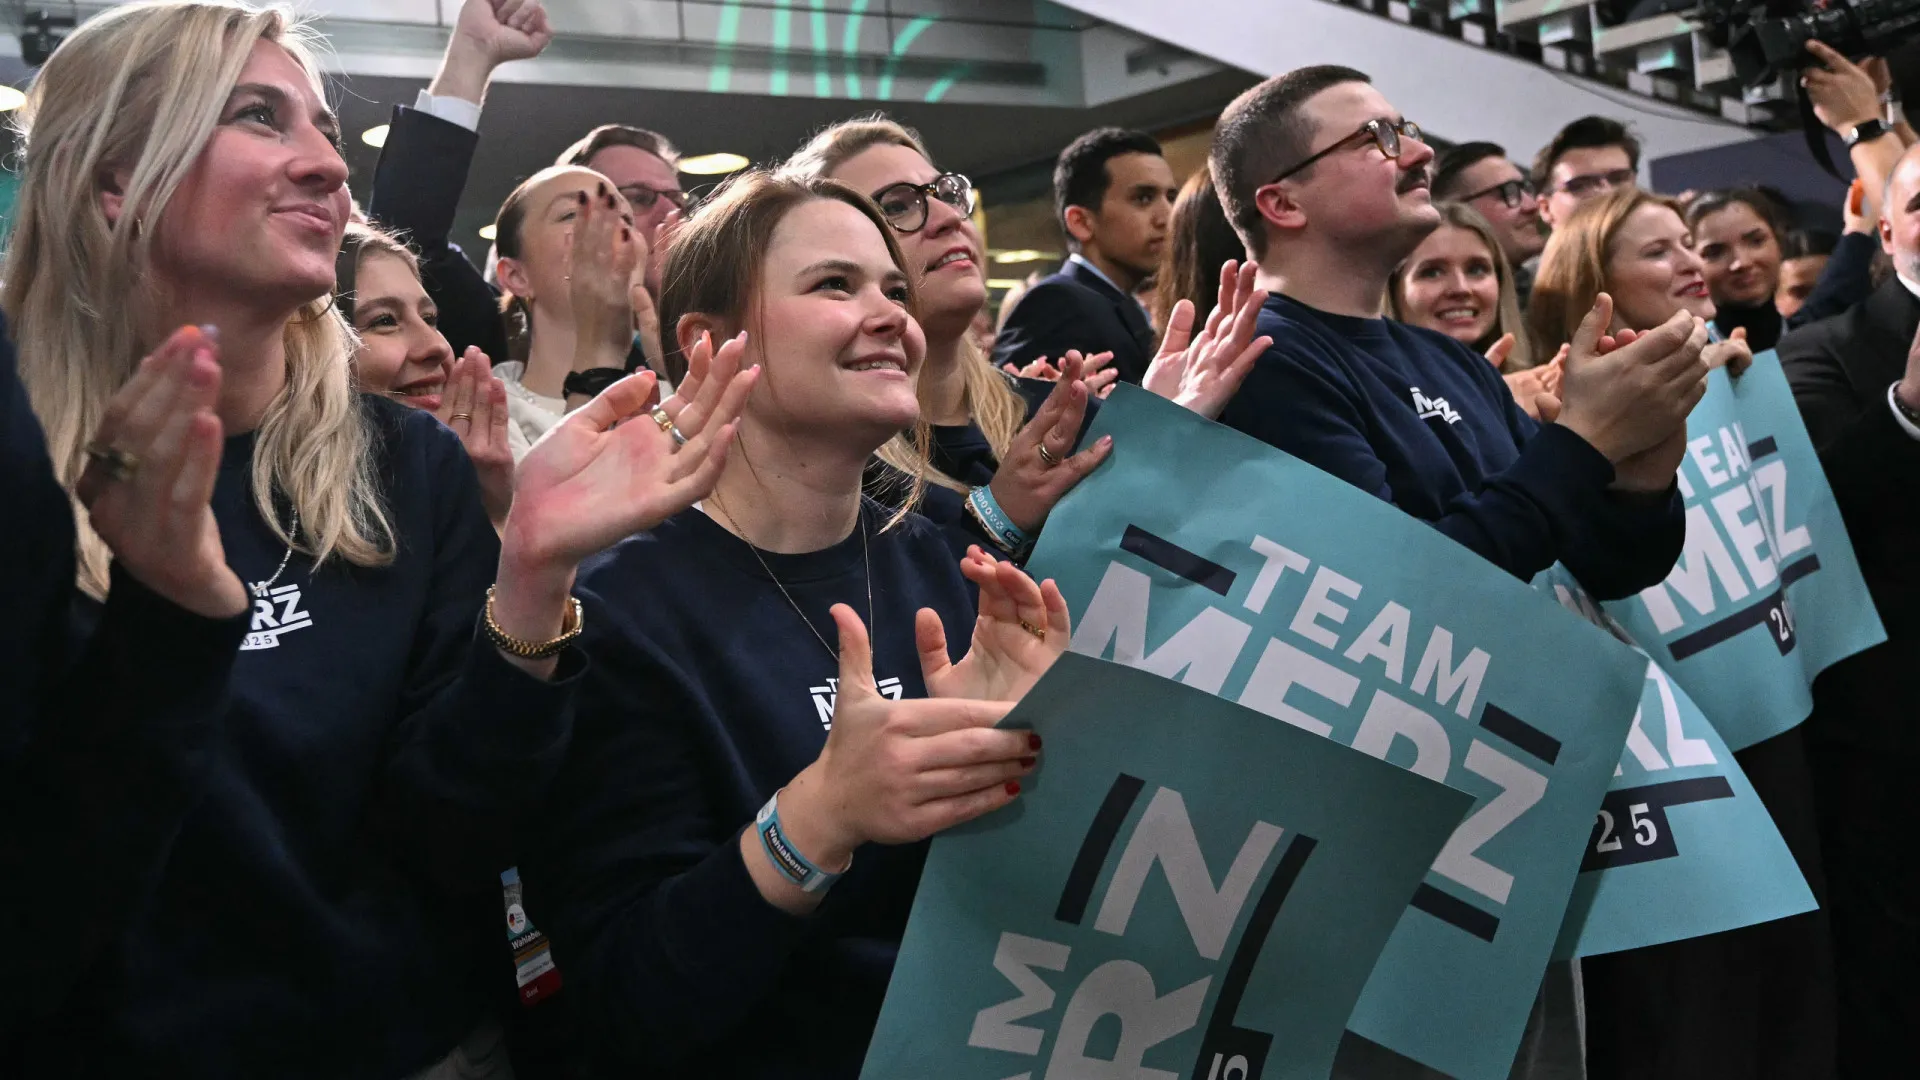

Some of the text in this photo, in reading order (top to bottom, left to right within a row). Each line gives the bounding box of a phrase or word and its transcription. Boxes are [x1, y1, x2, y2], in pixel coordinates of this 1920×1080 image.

[252, 590, 309, 631] RZ
[1242, 534, 1492, 720] TEAM
[769, 825, 808, 876] Wahlabend
[1595, 802, 1658, 853] 25
[1043, 785, 1284, 1080] RZ
